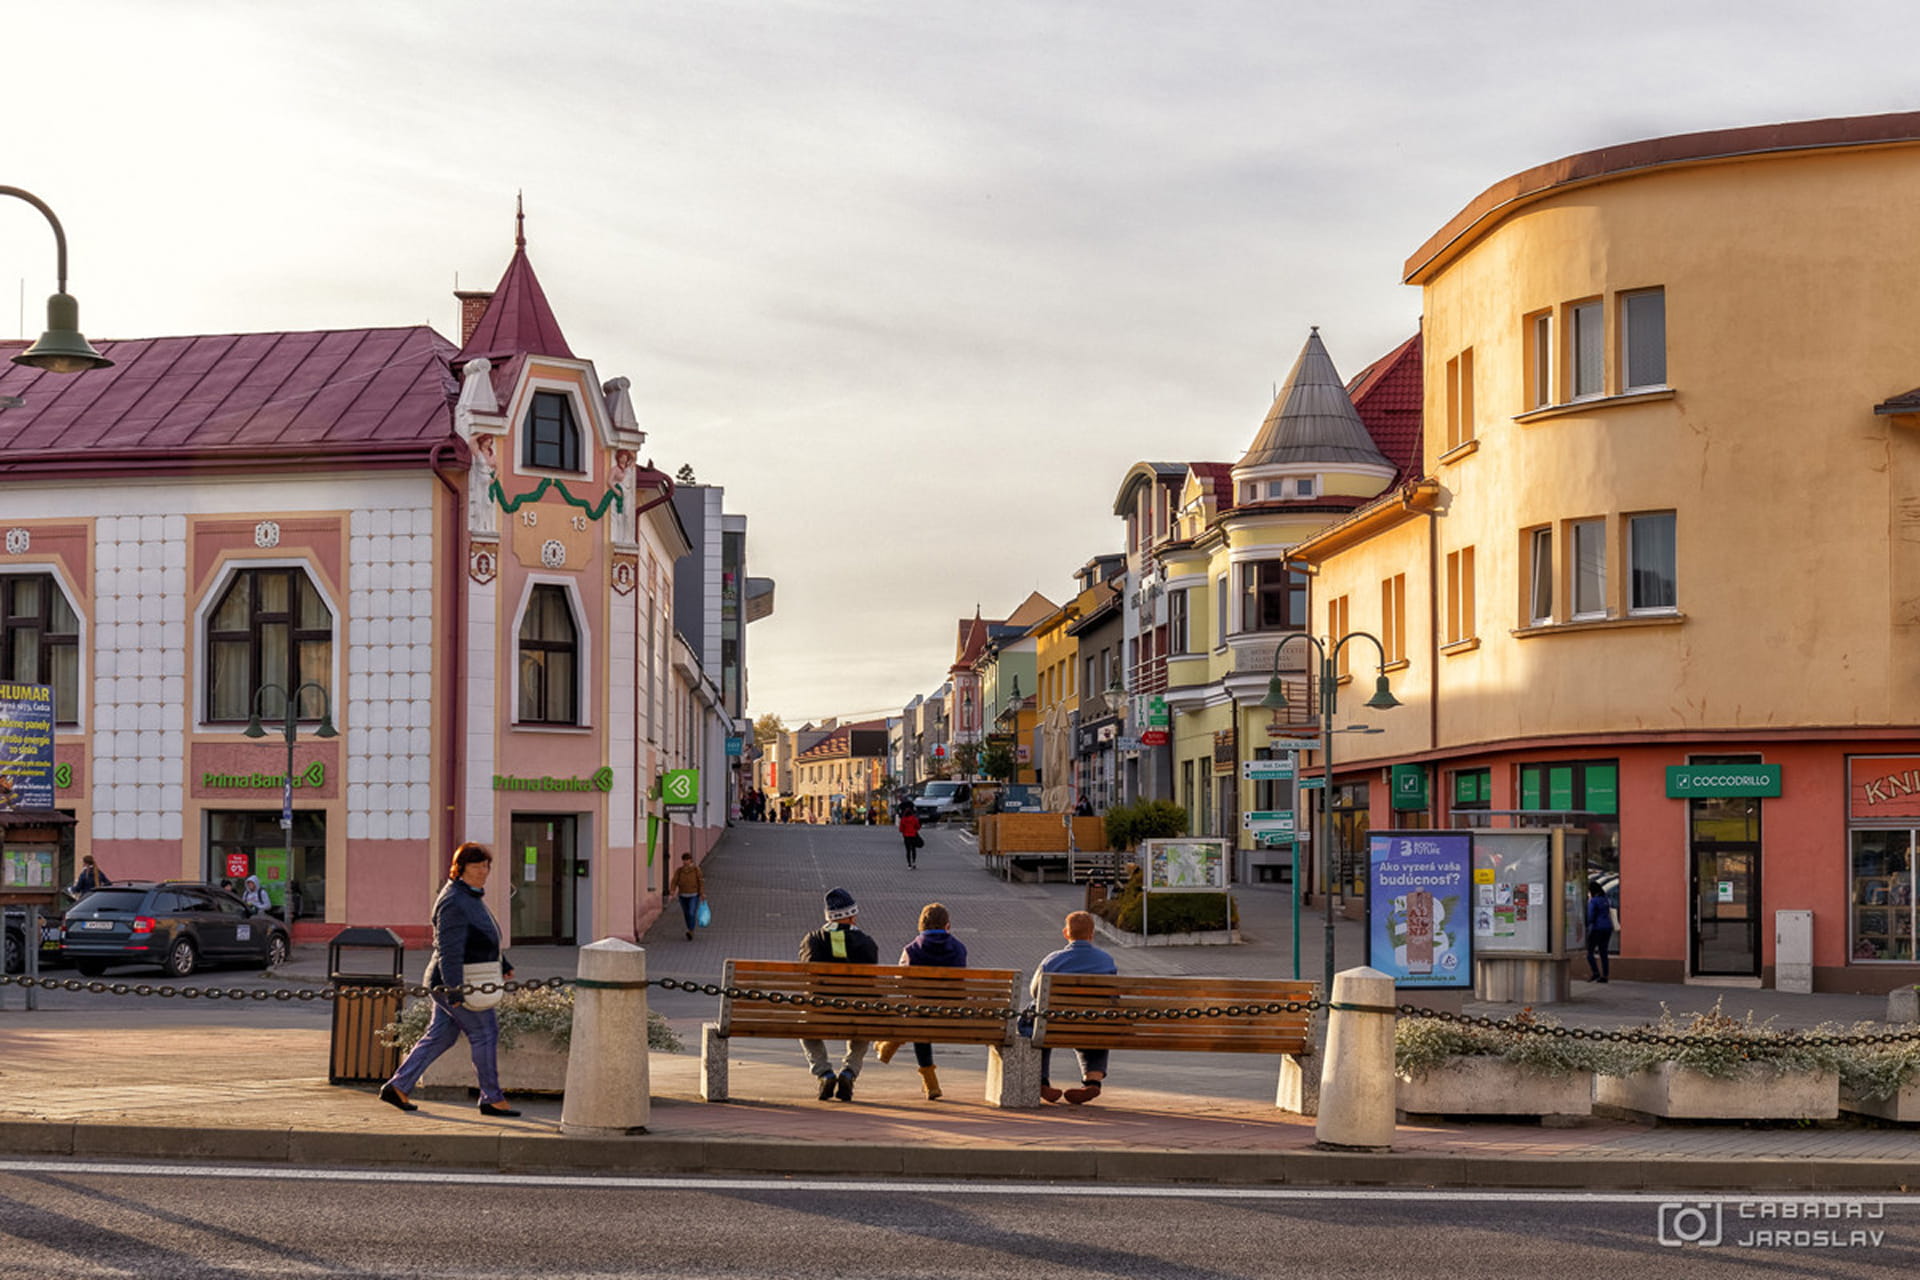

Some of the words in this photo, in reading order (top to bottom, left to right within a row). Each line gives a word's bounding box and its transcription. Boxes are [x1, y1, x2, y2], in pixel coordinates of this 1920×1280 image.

[521, 511, 537, 527] 19
[571, 516, 586, 531] 13
[202, 773, 249, 788] Prima
[493, 774, 540, 791] Prima
[542, 775, 593, 791] Banka
[1693, 775, 1770, 786] COCCODRILLO
[1380, 862, 1400, 871] Ako
[1402, 862, 1435, 873] vyzerá
[1437, 861, 1461, 871] vaša
[1380, 873, 1460, 886] budúcnosť?
